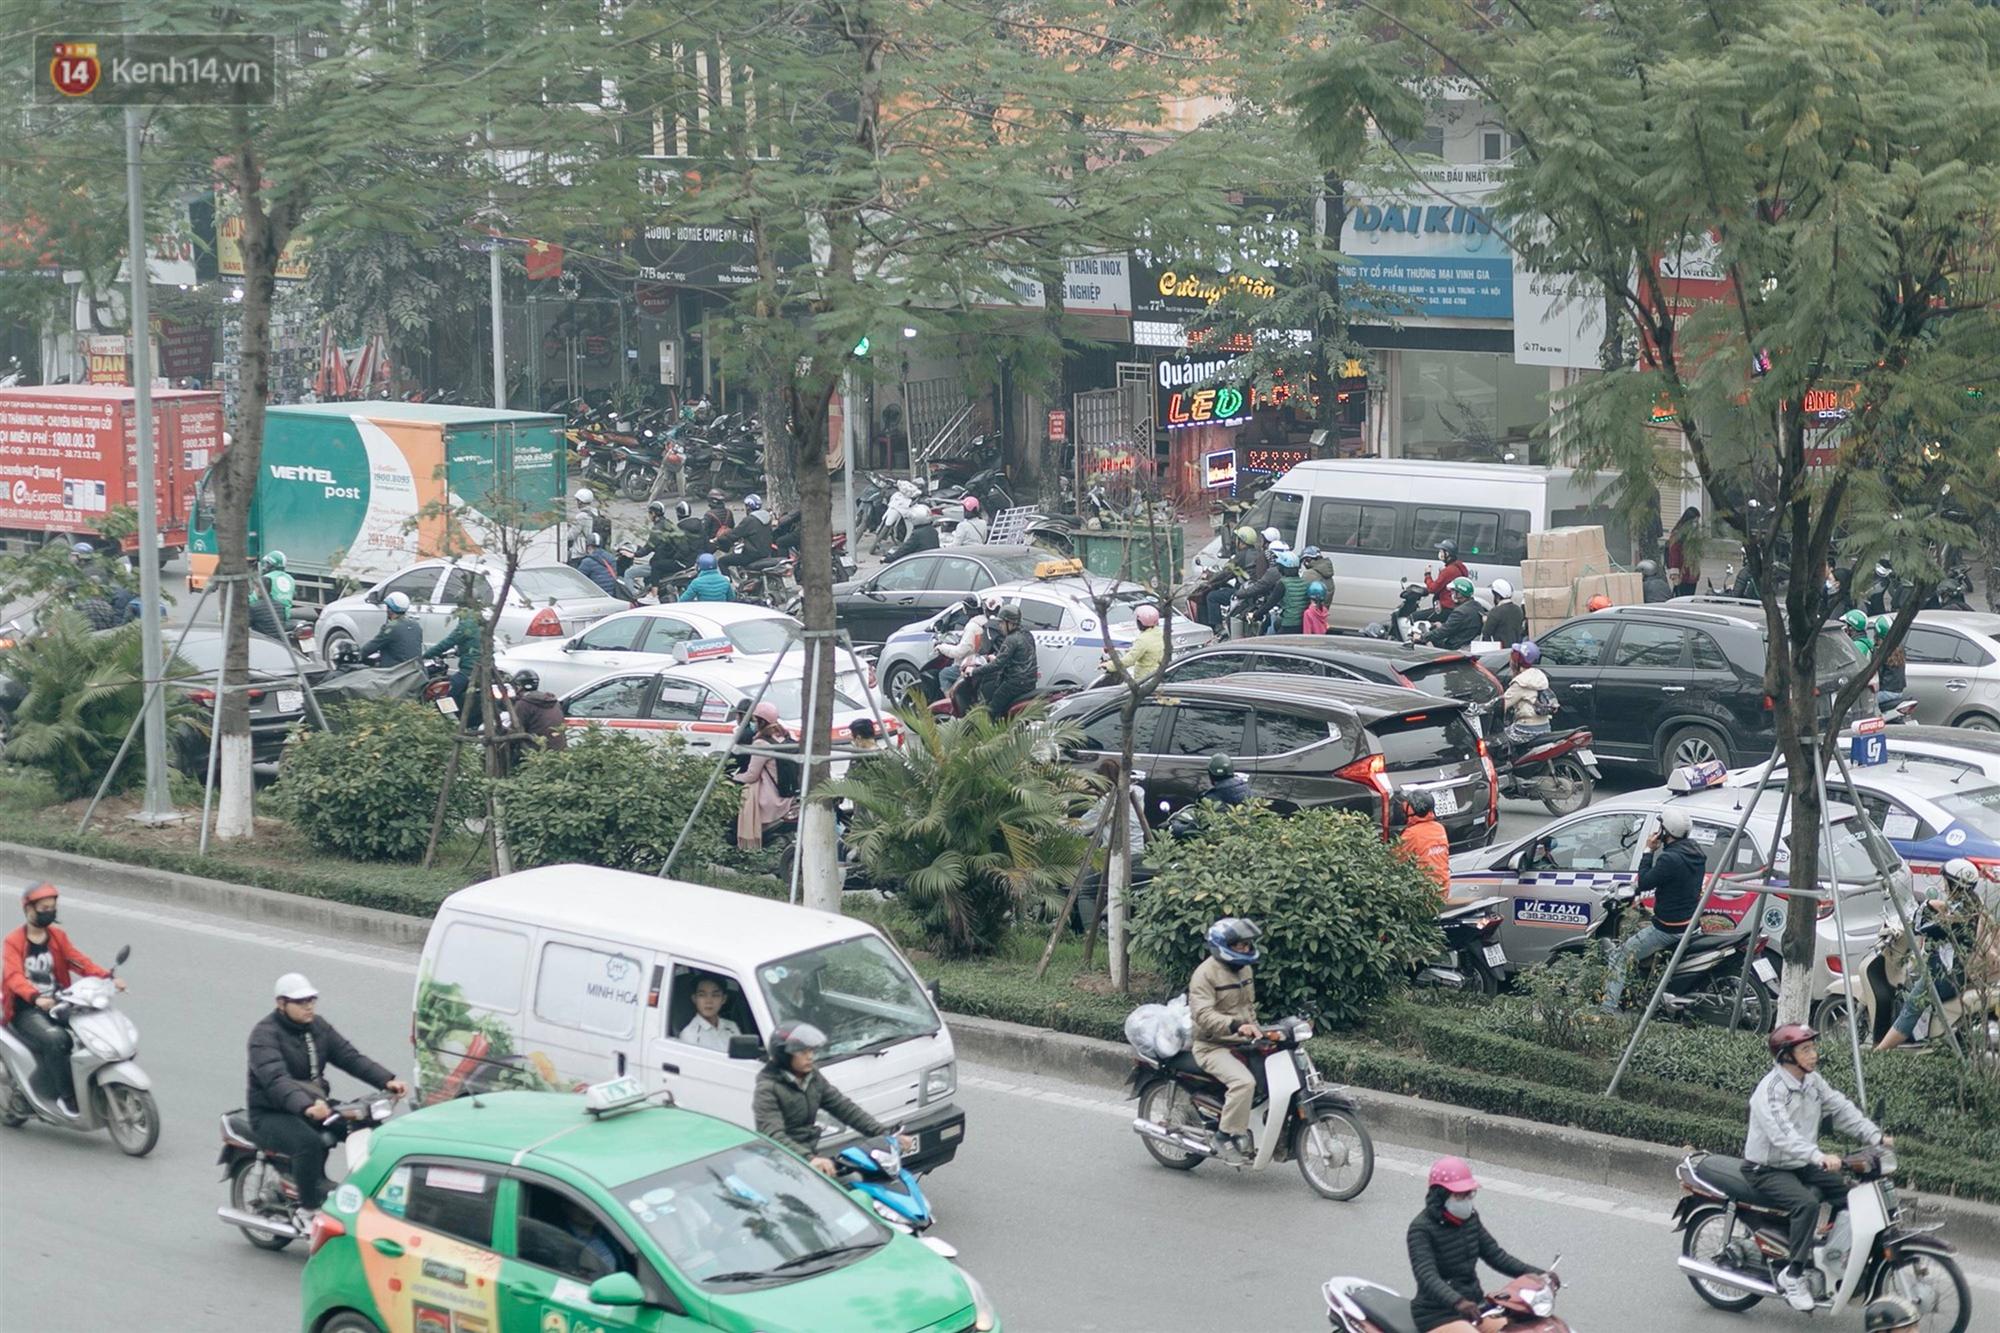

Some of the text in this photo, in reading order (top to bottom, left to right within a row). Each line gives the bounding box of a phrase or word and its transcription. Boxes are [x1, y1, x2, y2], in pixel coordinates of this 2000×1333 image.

[1353, 204, 1494, 234] DAIKIN
[1100, 261, 1121, 275] INOX
[1455, 269, 1474, 280] VINH
[1476, 270, 1490, 280] GIA
[1169, 387, 1243, 424] LED
[325, 486, 361, 500] post
[1549, 903, 1581, 915] TAXI
[587, 983, 613, 999] MINH
